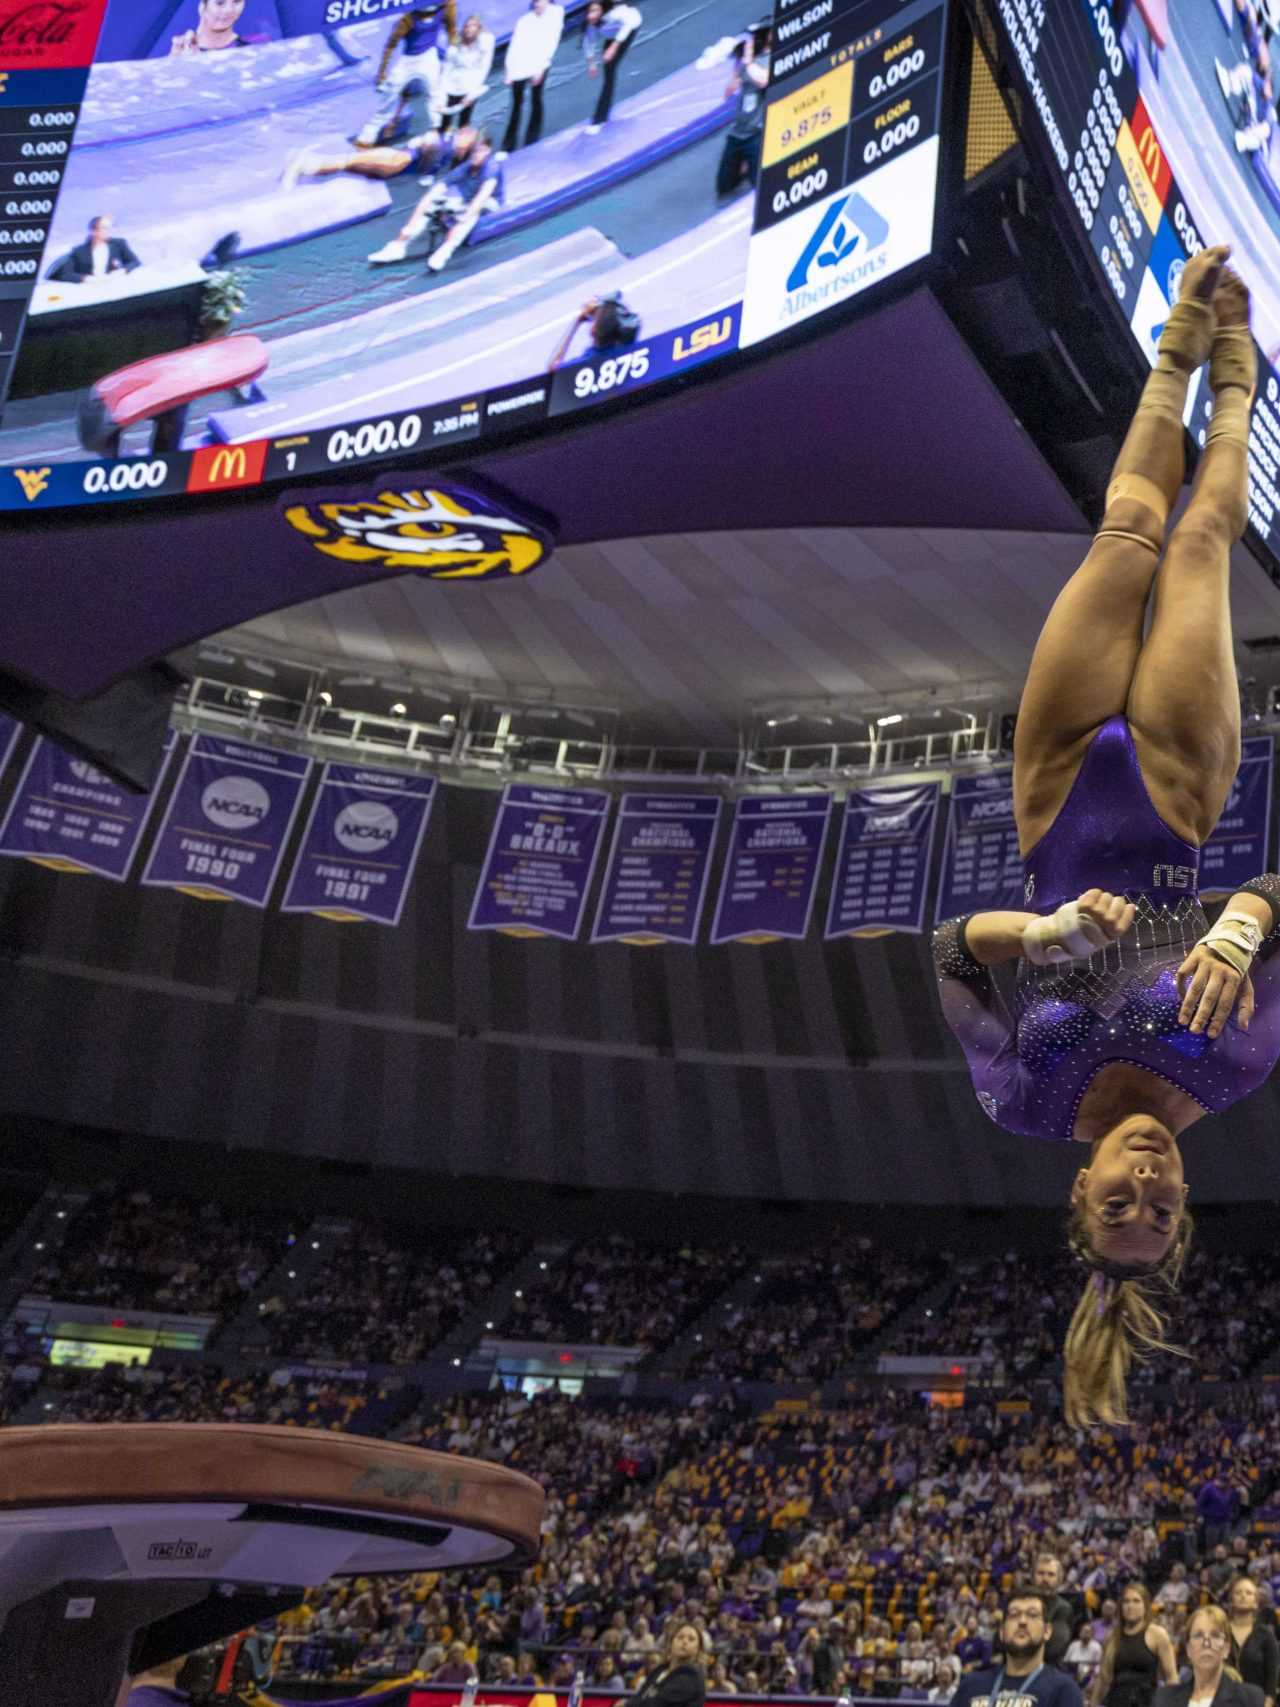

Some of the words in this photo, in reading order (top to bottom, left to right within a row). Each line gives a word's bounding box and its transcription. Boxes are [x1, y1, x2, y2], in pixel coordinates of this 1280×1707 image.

[778, 1, 833, 41] WILSON
[774, 32, 831, 77] BRYANT
[869, 49, 925, 98] 0.000
[29, 112, 75, 127] 0.000
[781, 107, 832, 147] 9.875
[21, 141, 67, 156] 0.000
[863, 115, 920, 163] 0.000
[14, 170, 60, 186] 0.000
[773, 169, 828, 213] 0.000
[5, 200, 52, 216] 0.000
[780, 253, 887, 320] Albertsons
[574, 348, 649, 398] 9.875
[672, 316, 732, 361] LSU
[327, 415, 422, 462] 0:00.0
[286, 452, 296, 471] 1
[84, 460, 167, 493] 0.000
[207, 797, 263, 818] NCAA
[341, 824, 393, 840] NCAA
[510, 834, 580, 856] BREAUX
[180, 838, 217, 856] FINAL
[221, 847, 256, 864] FOUR
[186, 854, 240, 880] 1990
[315, 864, 351, 880] FINAL
[354, 870, 387, 884] FOUR
[325, 880, 370, 901] 1991
